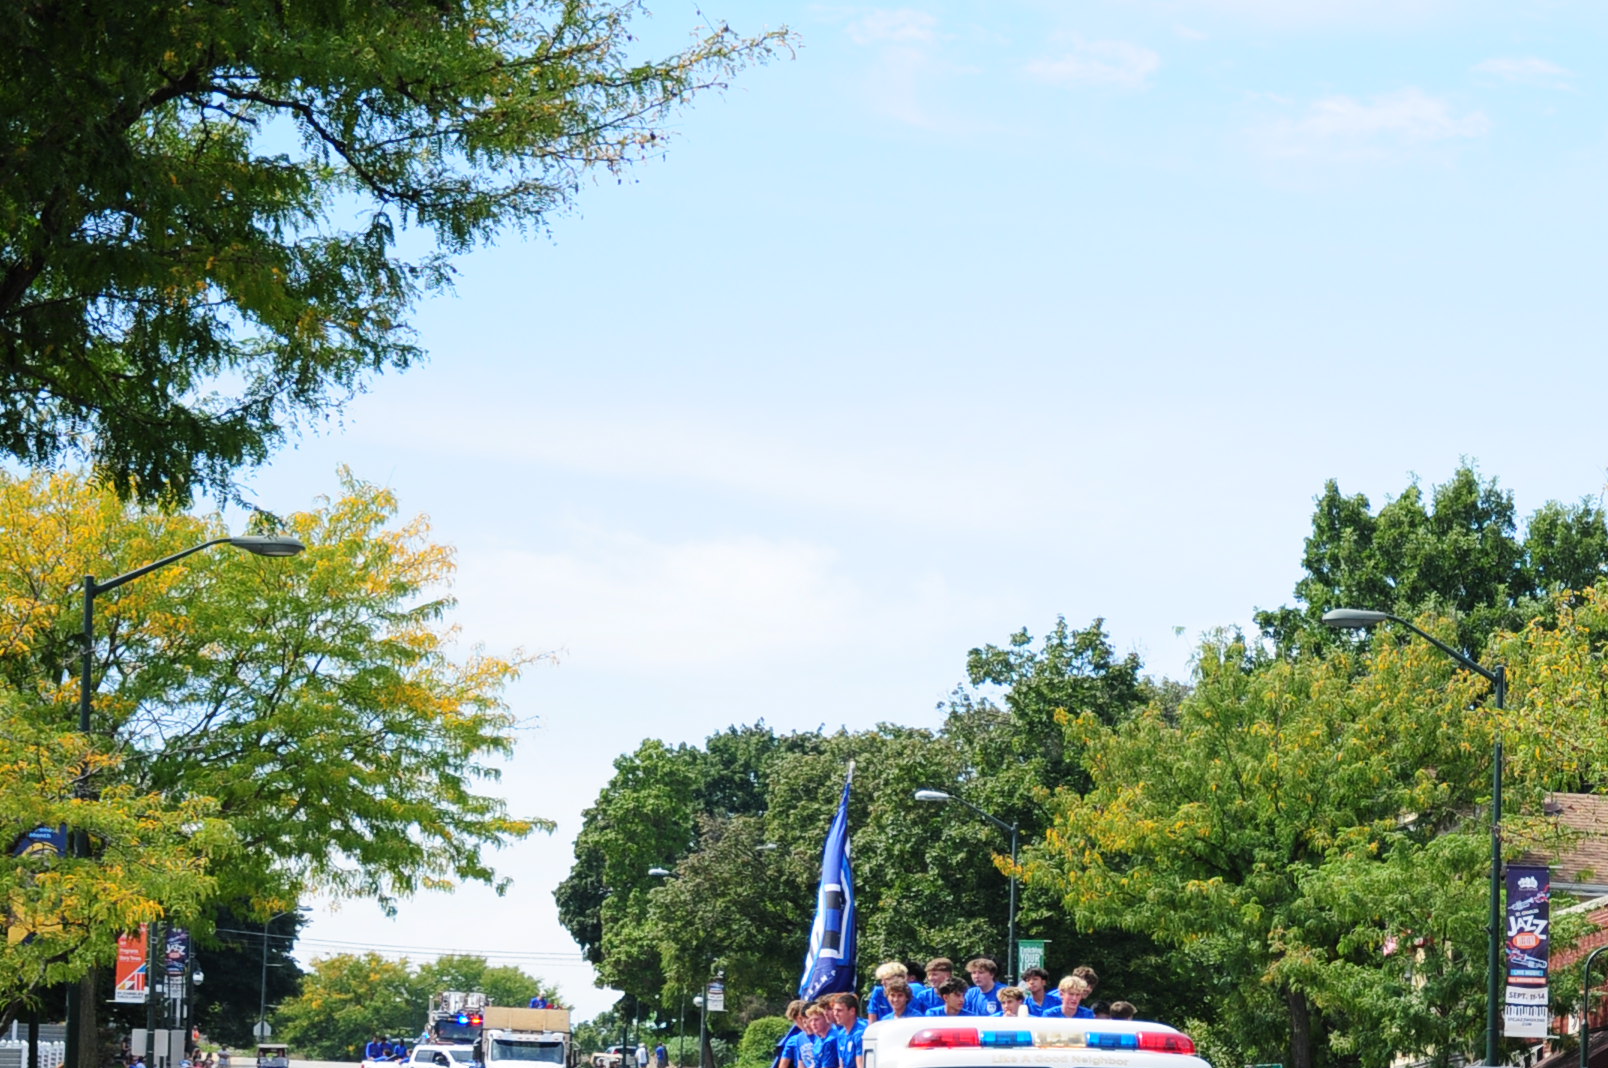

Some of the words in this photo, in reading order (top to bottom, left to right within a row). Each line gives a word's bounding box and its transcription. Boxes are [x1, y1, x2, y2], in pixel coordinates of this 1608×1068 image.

[1507, 915, 1549, 940] JAZZ
[1508, 992, 1528, 1000] SEPT.
[992, 1055, 1018, 1064] Like
[1022, 1055, 1031, 1064] A
[1036, 1056, 1068, 1064] Good
[1071, 1056, 1129, 1066] Neighbor
